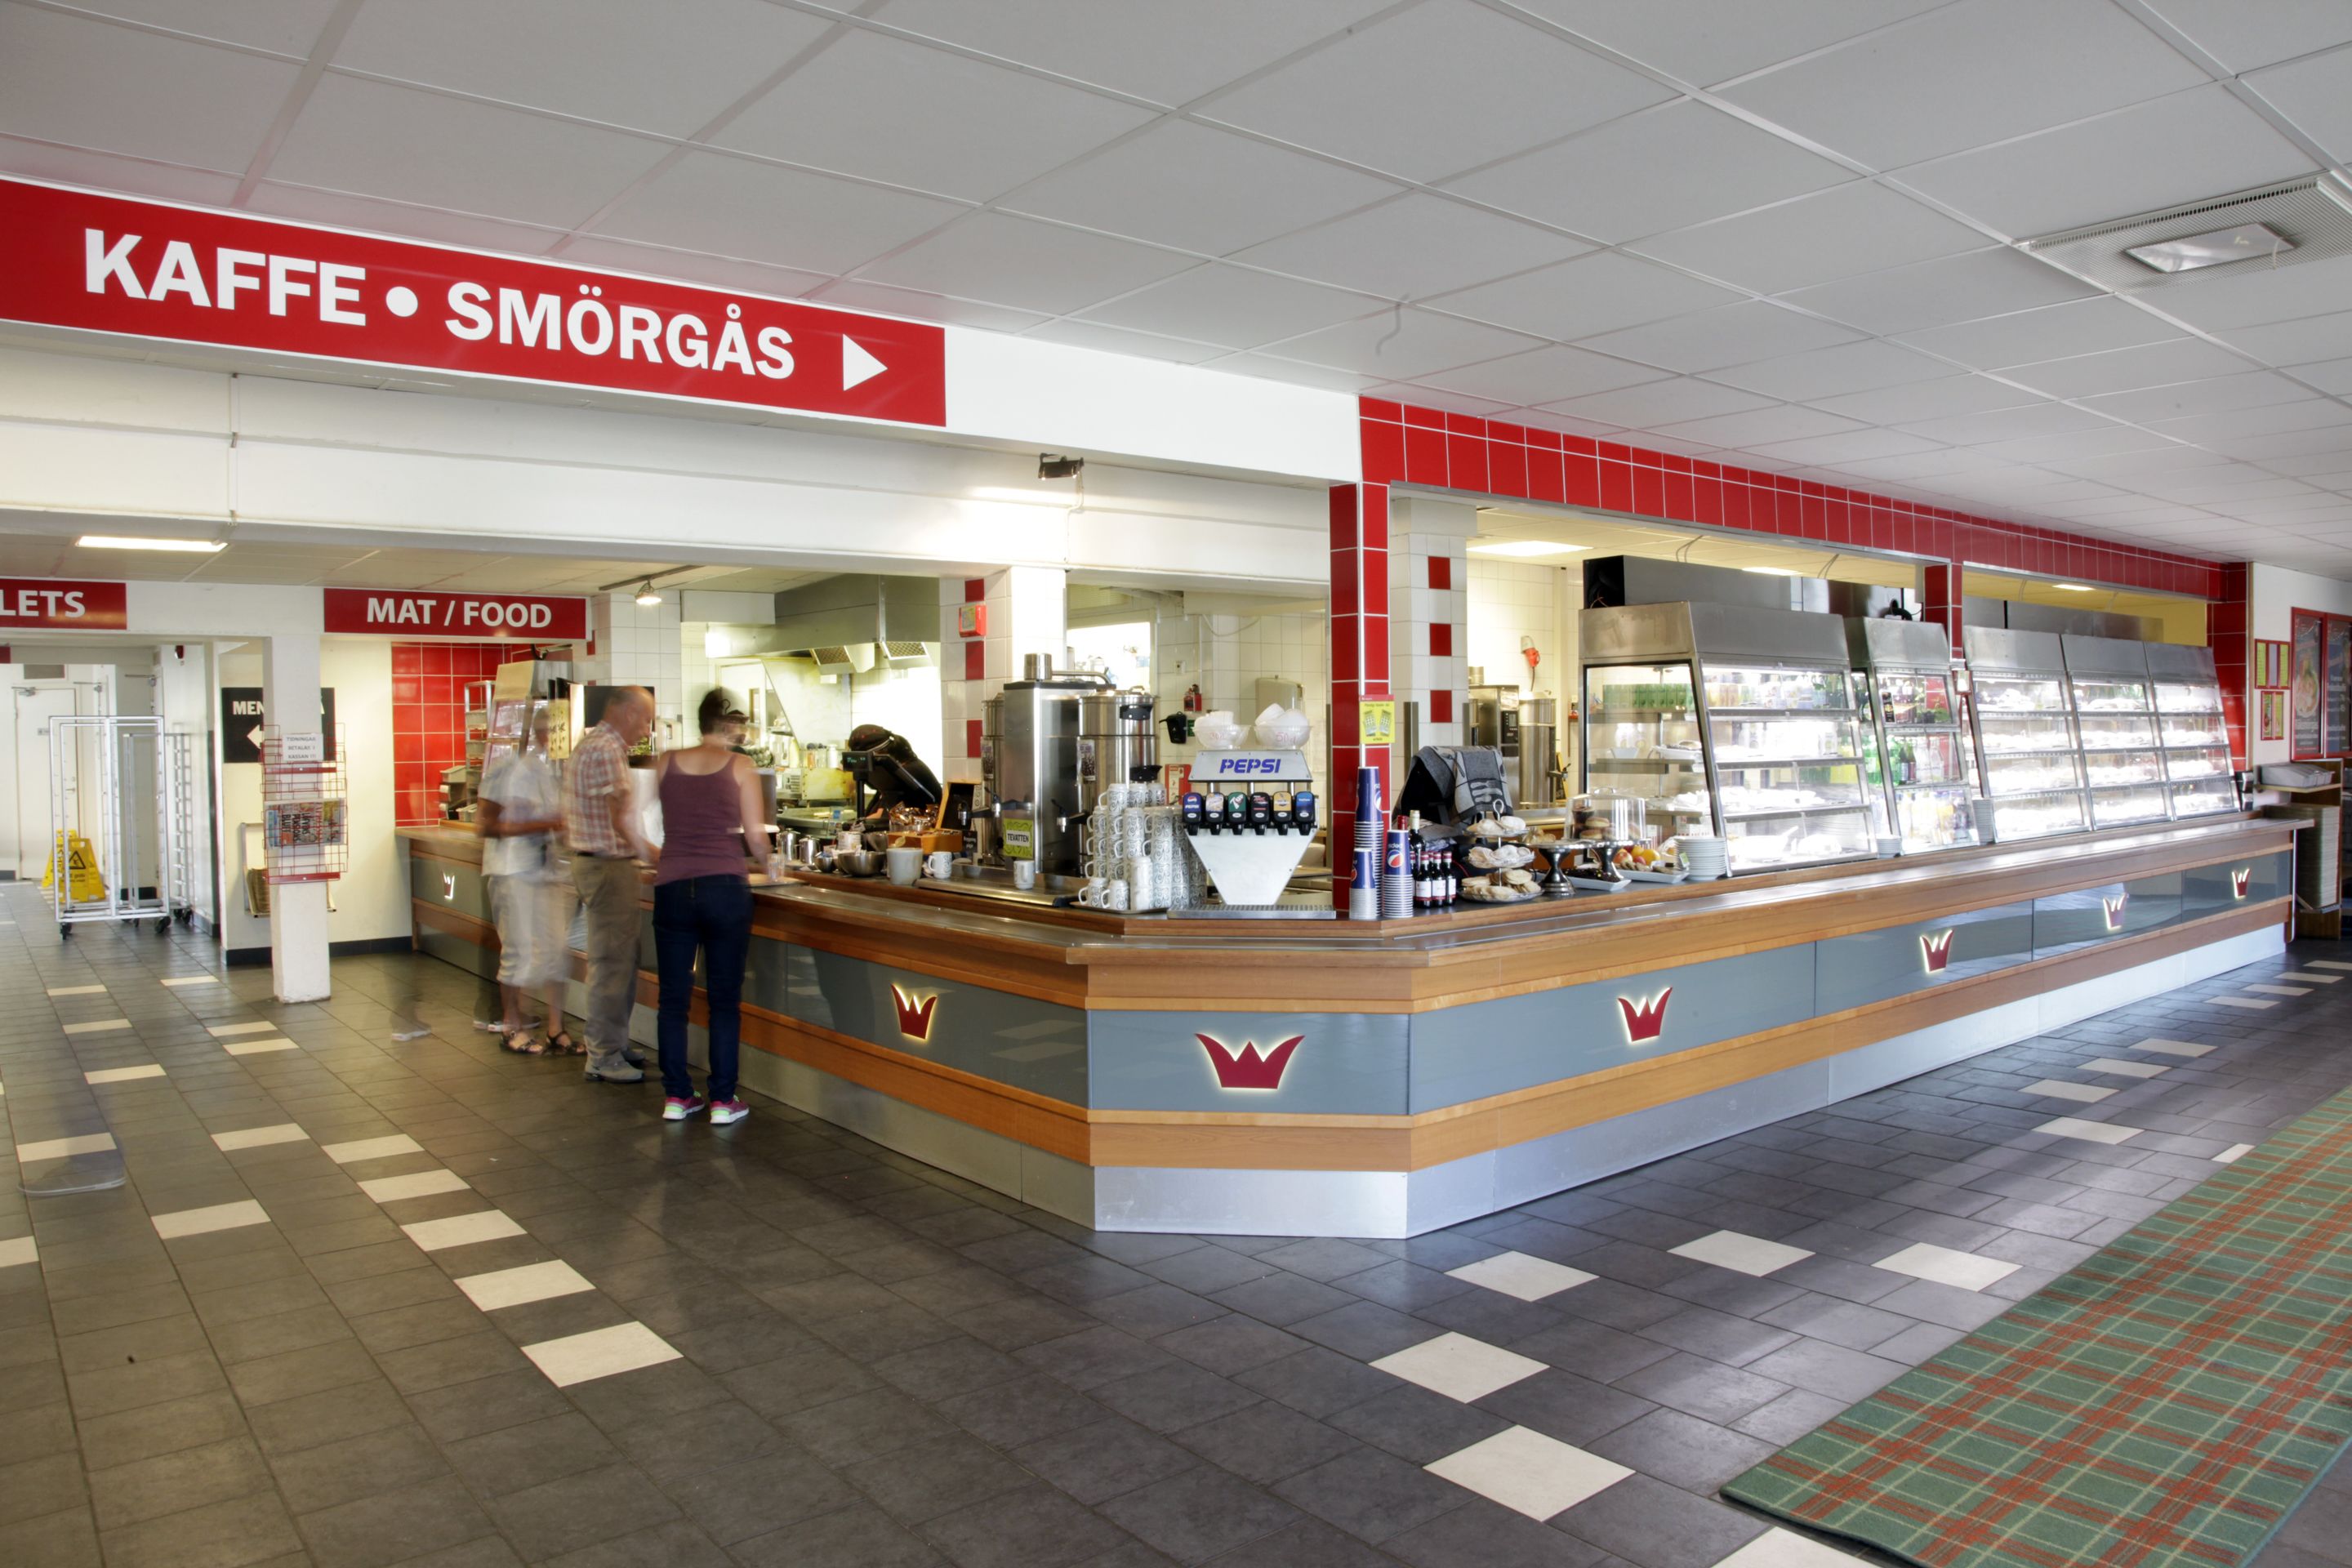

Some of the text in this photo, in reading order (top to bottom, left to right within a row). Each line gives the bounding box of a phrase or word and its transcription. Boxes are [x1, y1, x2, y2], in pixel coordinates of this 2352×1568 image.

[86, 228, 795, 380] KAFFE SMÖRGÅS
[0, 590, 85, 617] LETS
[367, 597, 436, 624] MAT
[464, 601, 552, 628] FOOD
[1219, 759, 1281, 773] PEPSI
[1007, 833, 1029, 843] TEVATTEN
